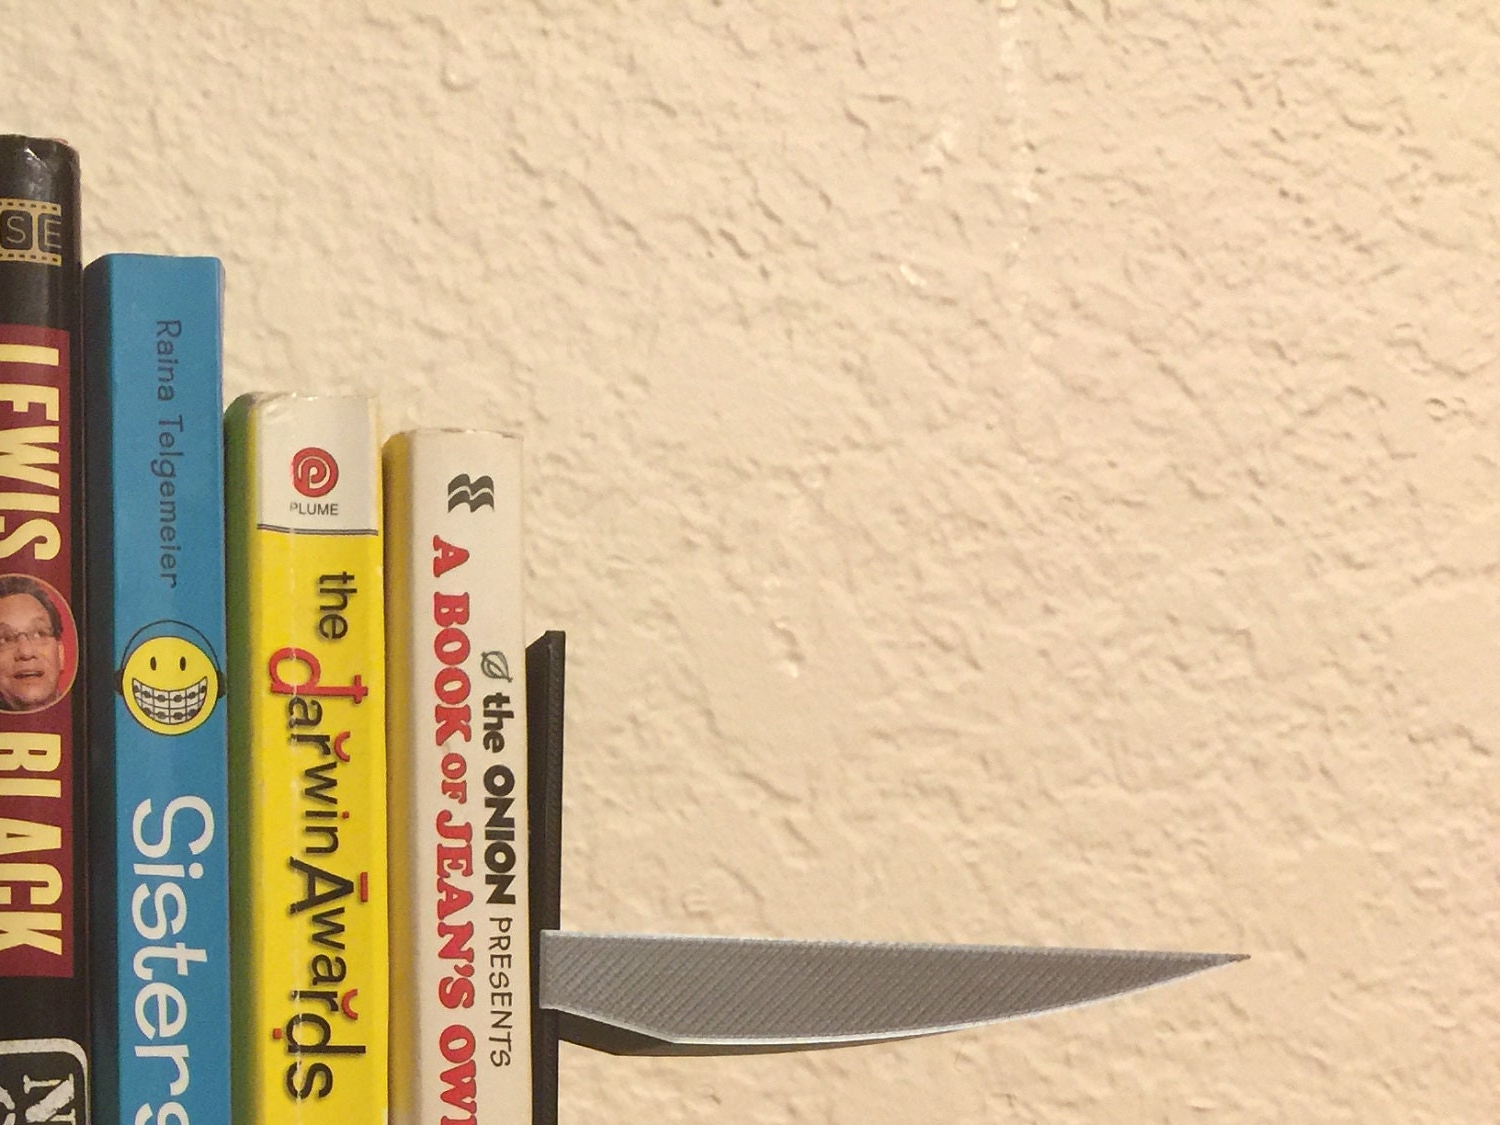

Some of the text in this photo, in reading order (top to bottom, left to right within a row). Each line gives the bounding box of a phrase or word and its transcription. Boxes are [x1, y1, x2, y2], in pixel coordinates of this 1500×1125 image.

[150, 319, 184, 590] Raina Telgemeier
[289, 501, 339, 517] PLUME
[317, 571, 358, 641] the
[433, 534, 471, 579] A
[434, 591, 473, 747] BOOK
[440, 752, 468, 805] OF
[436, 809, 477, 1010] JEAN'S
[482, 692, 517, 1068] the ONION PRESENTS
